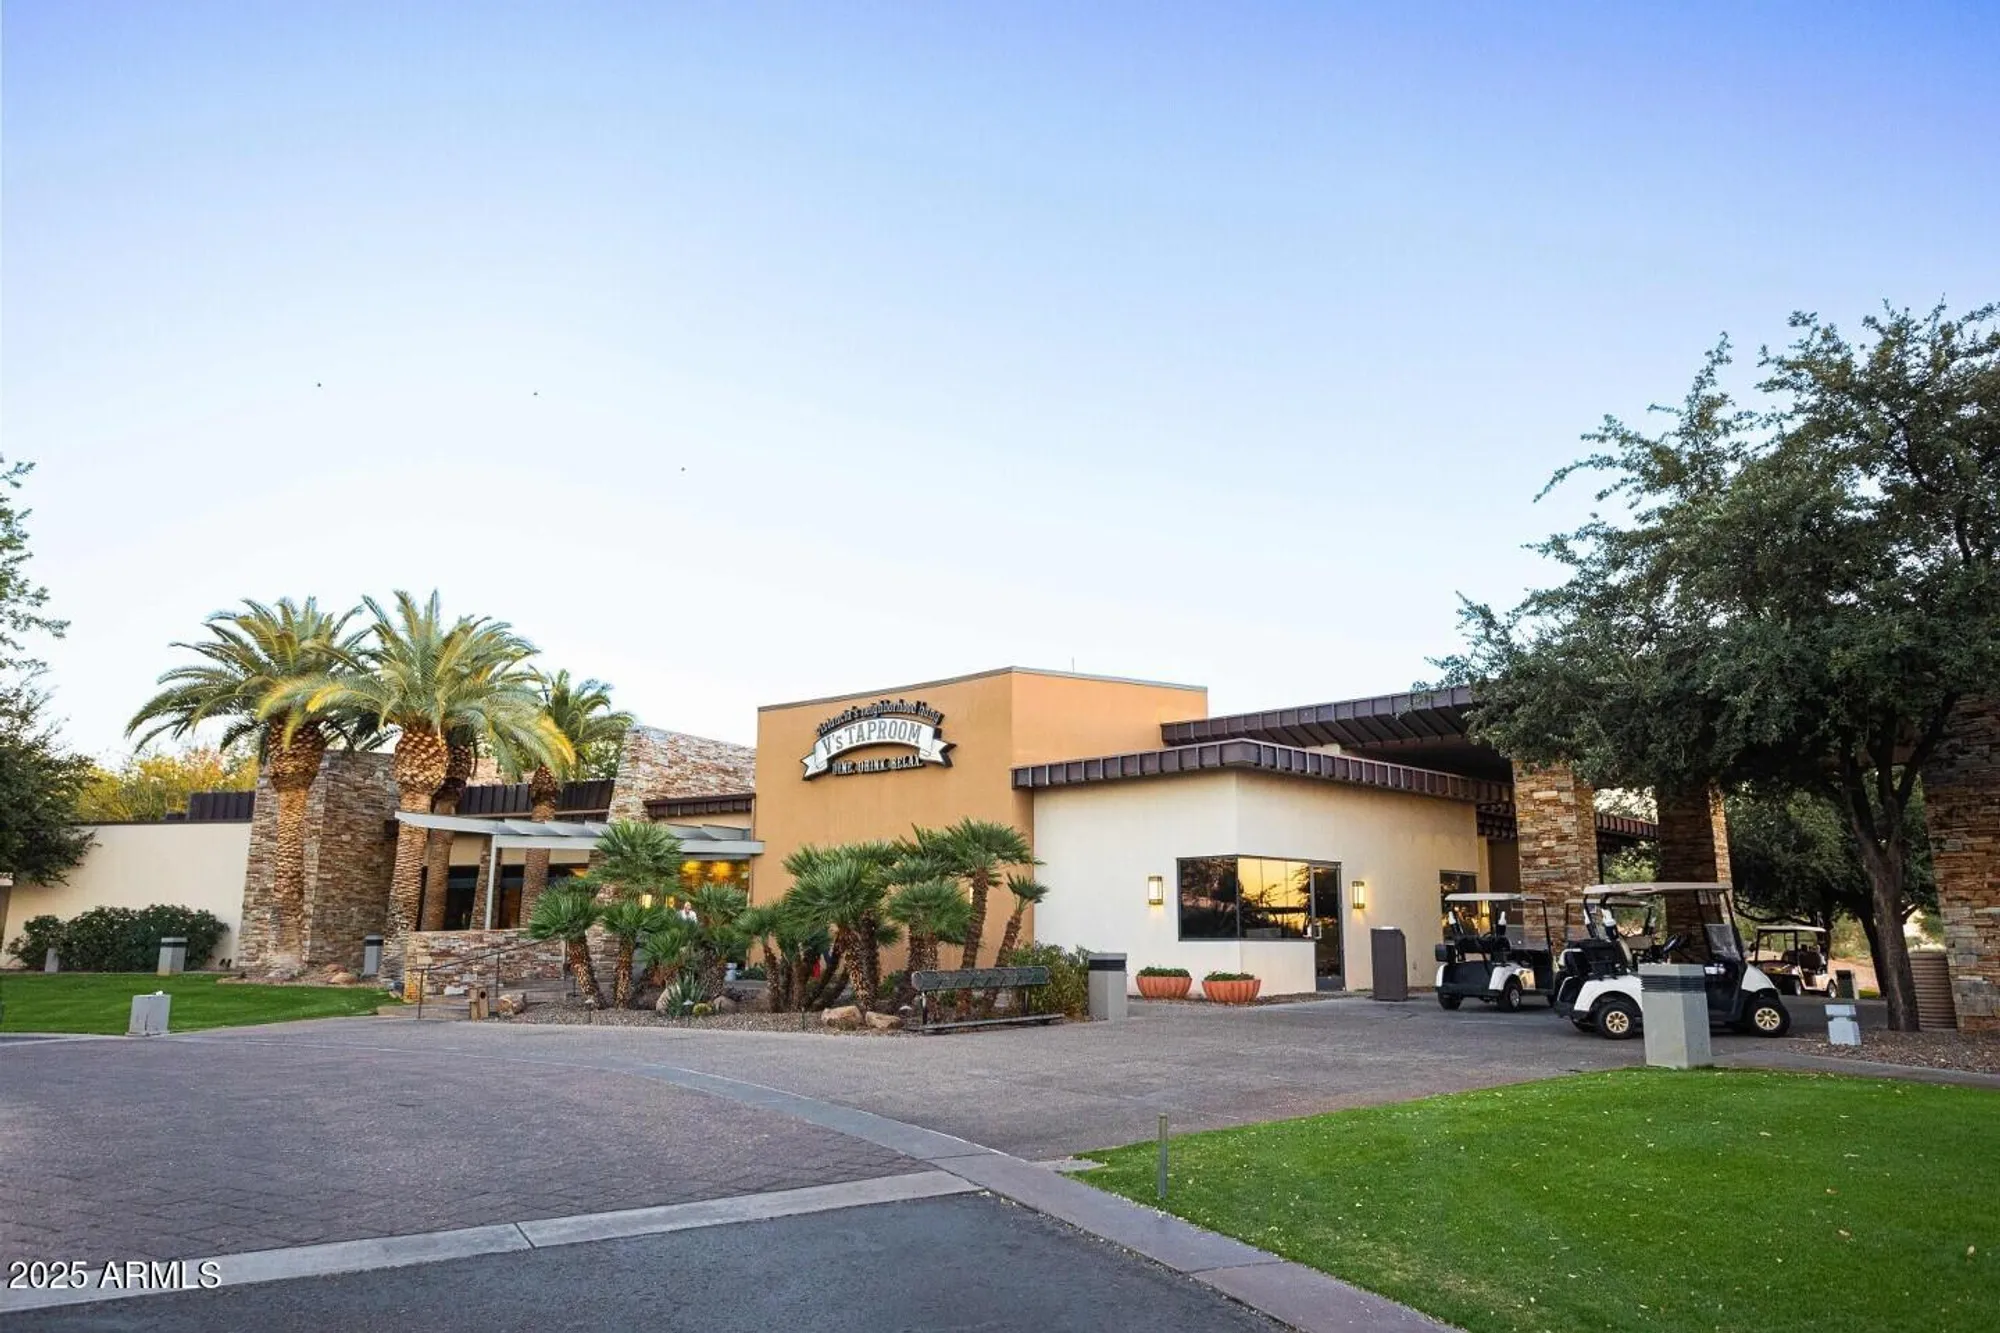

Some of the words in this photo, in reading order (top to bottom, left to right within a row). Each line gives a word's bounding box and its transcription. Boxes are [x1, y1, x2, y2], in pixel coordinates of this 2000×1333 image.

[821, 736, 843, 756] V's
[844, 720, 922, 745] TAPROOM
[832, 761, 855, 774] DINE.
[890, 755, 923, 770] RELAX.
